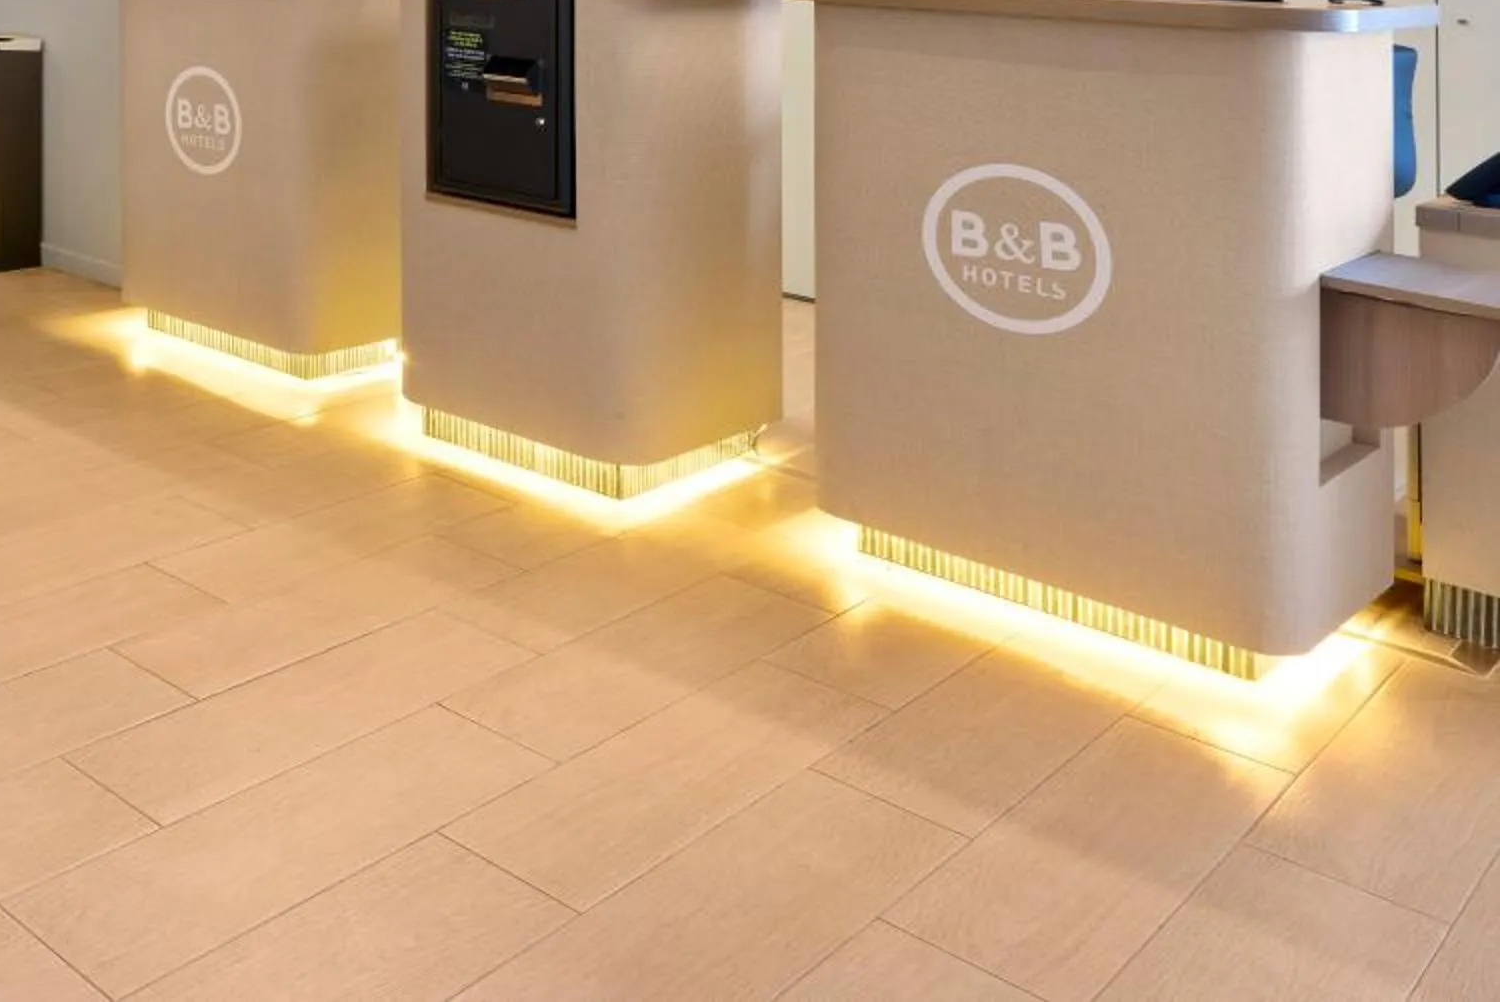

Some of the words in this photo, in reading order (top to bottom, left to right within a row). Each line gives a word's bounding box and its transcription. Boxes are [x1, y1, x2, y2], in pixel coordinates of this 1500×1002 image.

[178, 98, 231, 134] B&B
[951, 209, 1082, 271] B&B
[962, 265, 1067, 300] HOTELS
